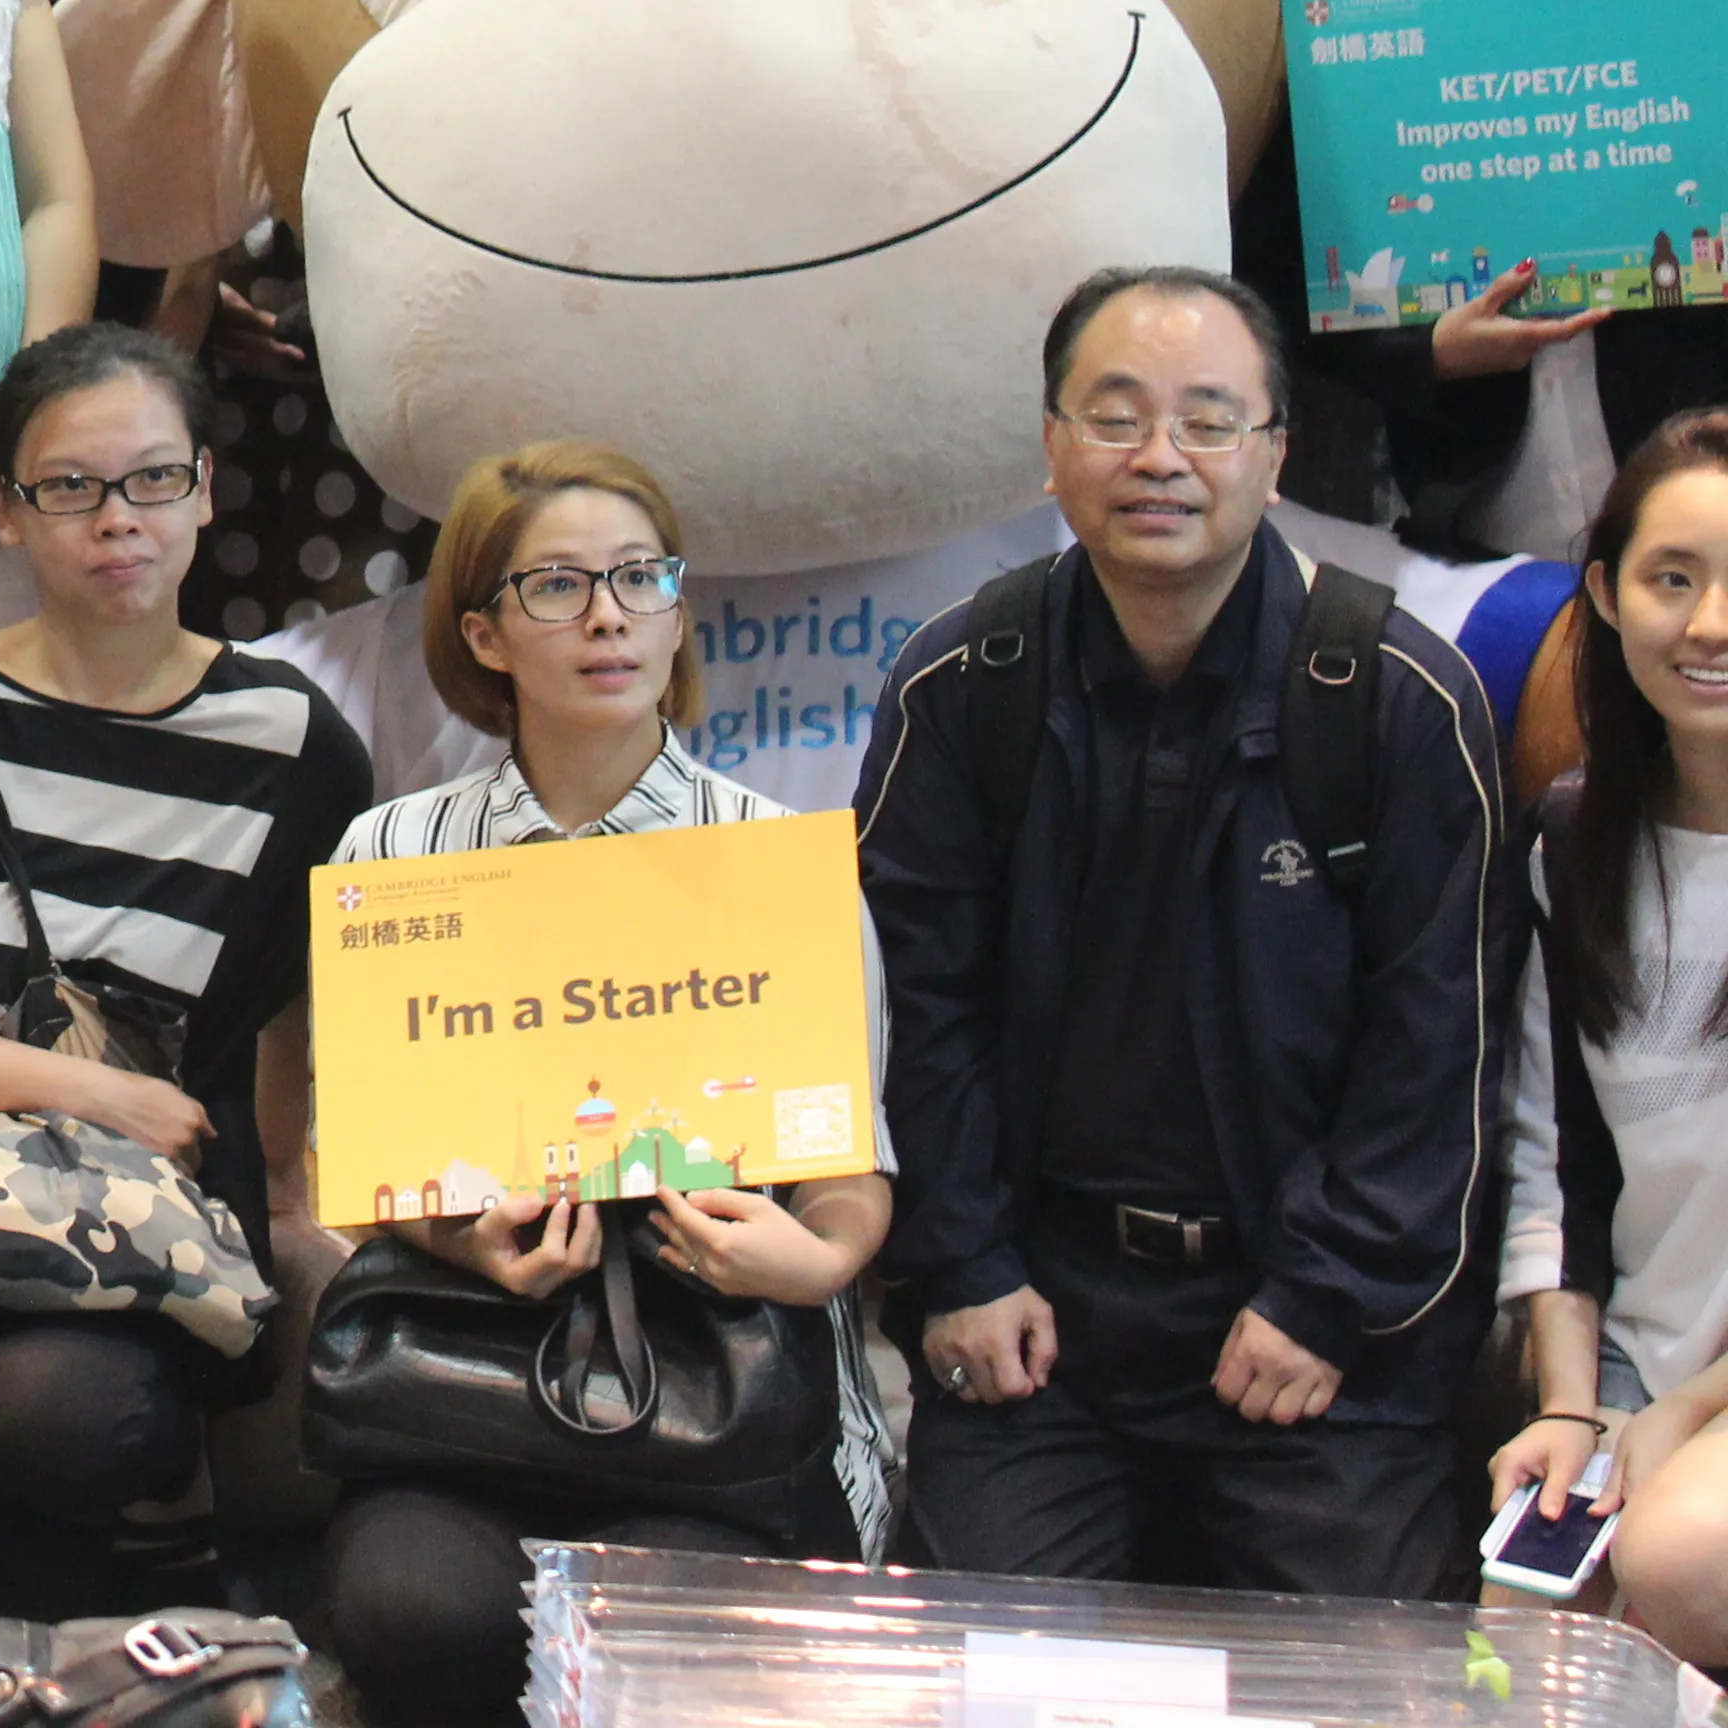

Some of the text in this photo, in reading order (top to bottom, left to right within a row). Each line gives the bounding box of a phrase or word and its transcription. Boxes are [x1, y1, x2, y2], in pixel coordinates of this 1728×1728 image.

[1440, 60, 1639, 103] KET/PET/FCE
[1397, 96, 1691, 148] Improves my English
[1421, 141, 1672, 183] one step at a time
[695, 595, 923, 673] bridg
[690, 684, 877, 772] glish
[365, 869, 512, 893] CAMBRIDGE ENGLISH
[340, 912, 464, 951] 劍橋英語
[406, 968, 770, 1043] I'm a Starter
